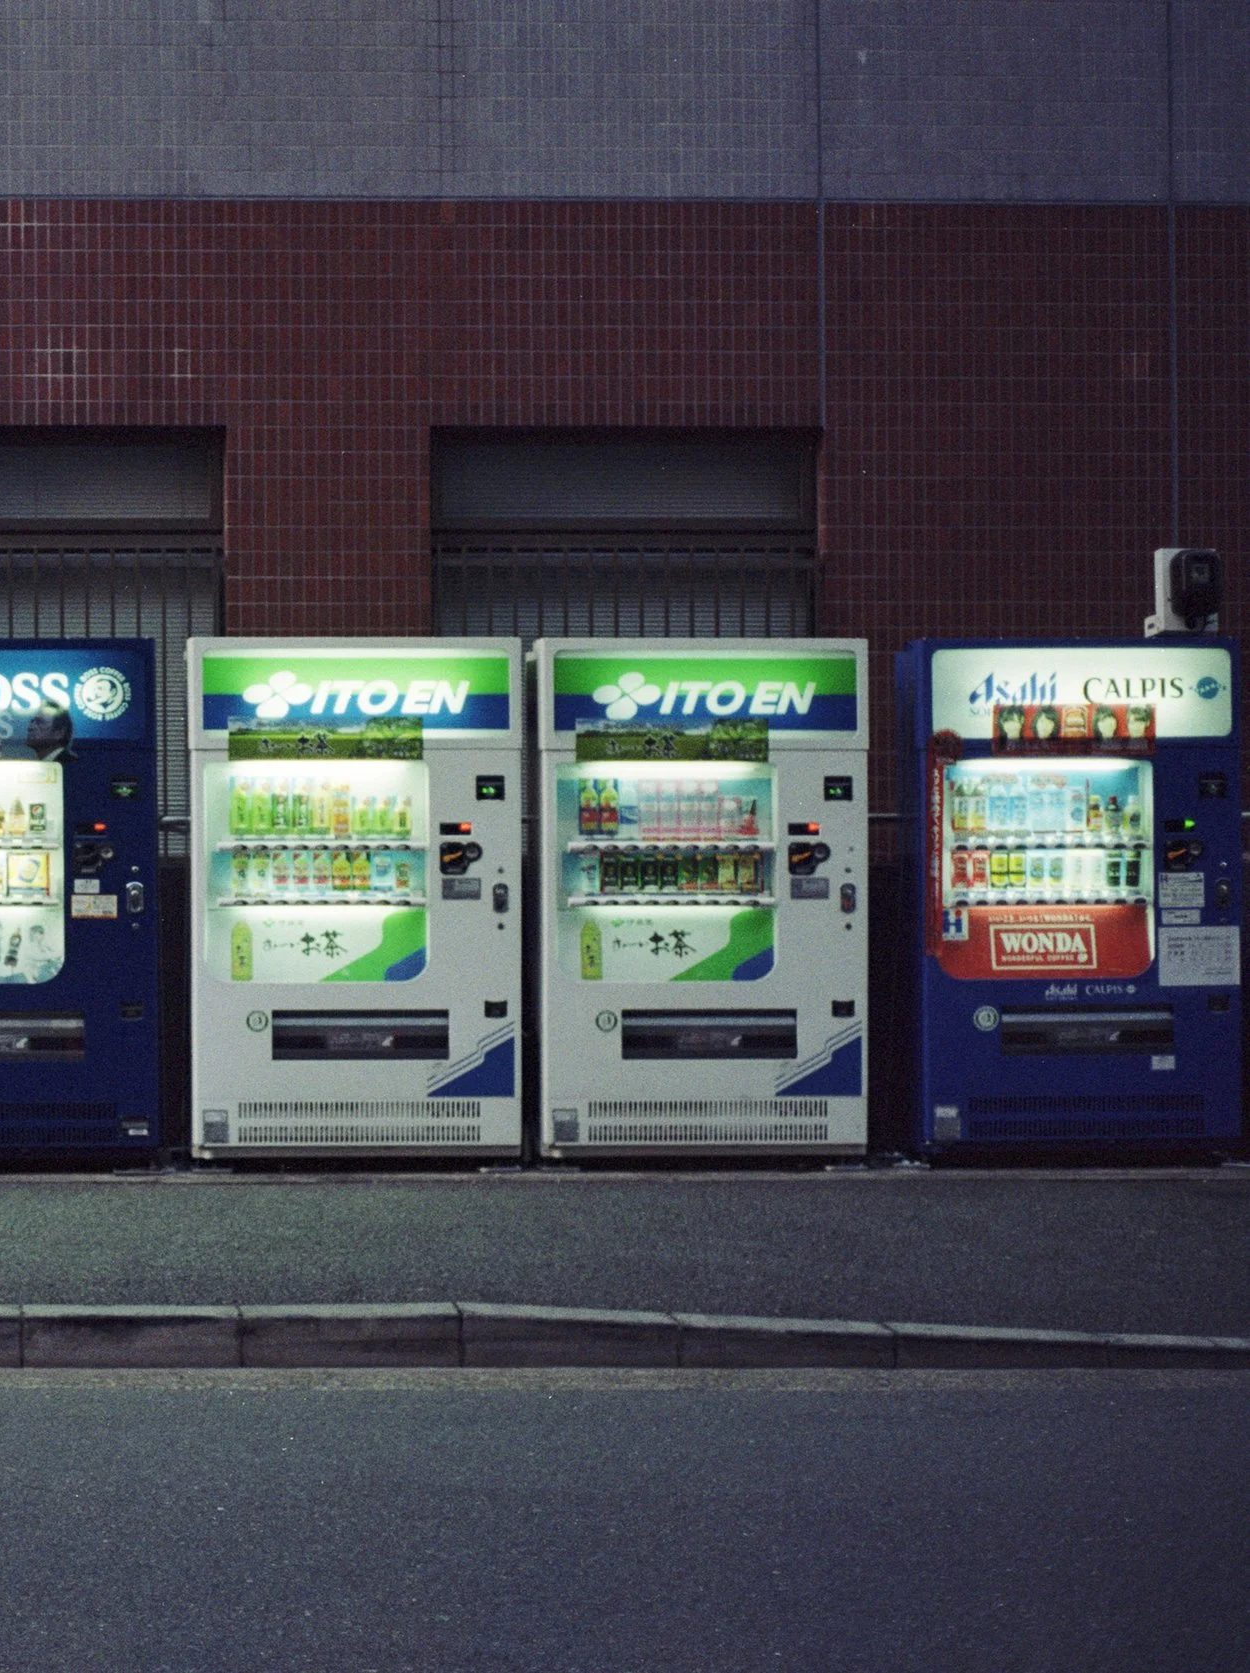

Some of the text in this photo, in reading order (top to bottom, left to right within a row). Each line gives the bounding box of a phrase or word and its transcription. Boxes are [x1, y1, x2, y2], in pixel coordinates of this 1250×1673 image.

[310, 680, 469, 715] ITO EN
[659, 681, 816, 716] ITO EN
[969, 672, 1058, 704] Asahi
[1083, 677, 1184, 704] CALPIS
[999, 932, 1087, 954] WONDA
[1044, 984, 1078, 997] Asahi
[1085, 985, 1123, 996] CALPIS
